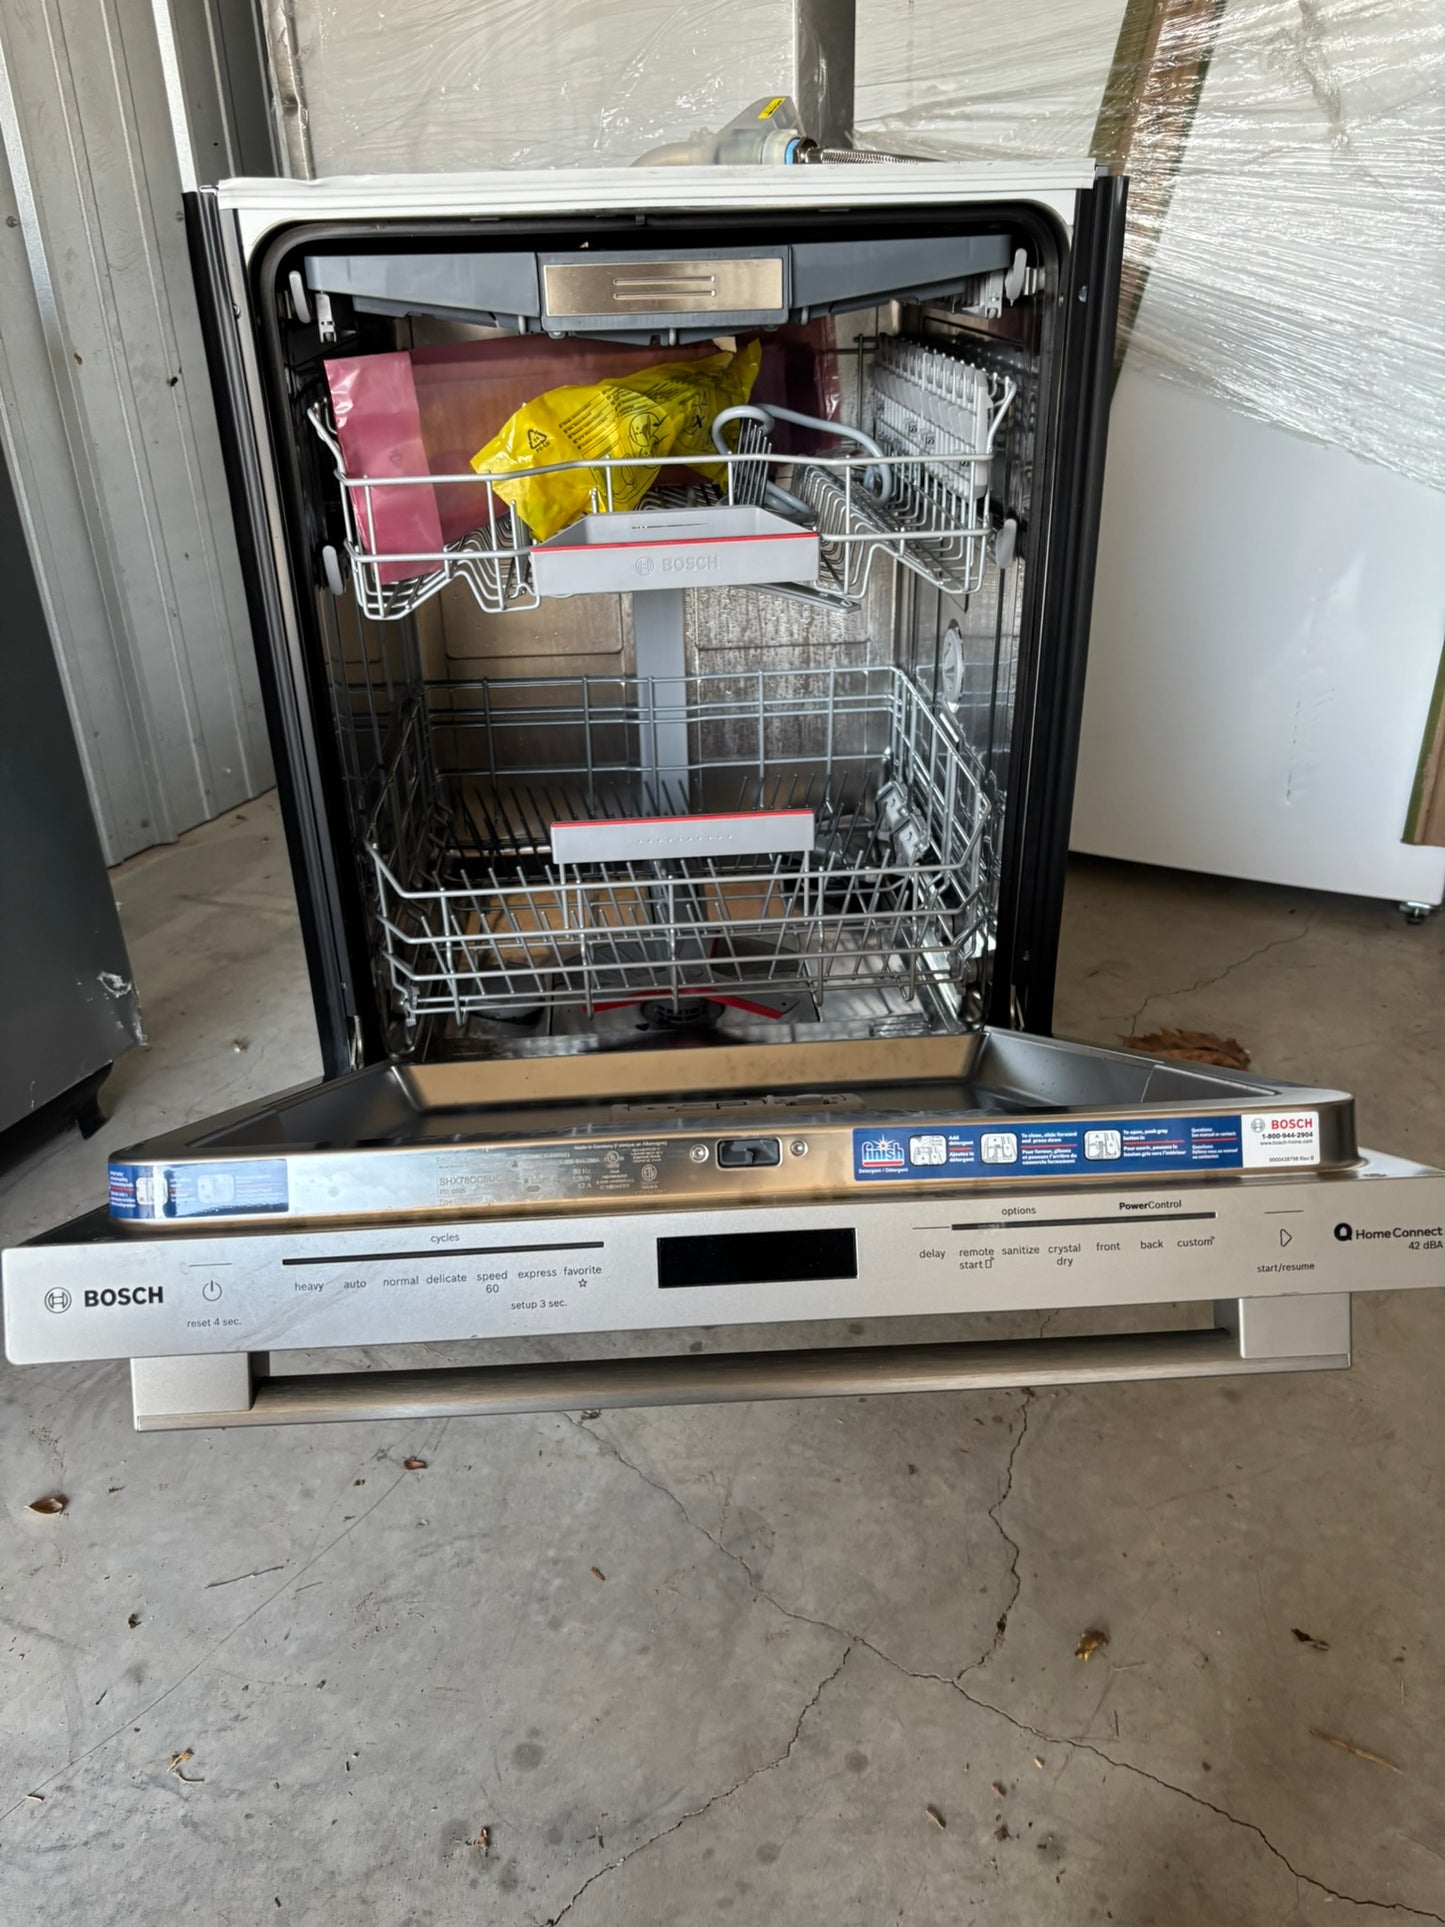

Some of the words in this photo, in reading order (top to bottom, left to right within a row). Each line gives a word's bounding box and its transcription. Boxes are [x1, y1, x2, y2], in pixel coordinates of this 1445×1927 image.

[661, 555, 720, 572] BOSCH
[1271, 1118, 1313, 1130] BOSCH
[1262, 1132, 1313, 1140] 1-800-944-2904
[862, 1141, 905, 1161] finish
[1119, 1200, 1182, 1210] PowerControl
[1001, 1206, 1036, 1217] options
[430, 1233, 460, 1244] cycles
[1355, 1228, 1392, 1240] Home
[1392, 1226, 1443, 1238] Connect
[1048, 1243, 1082, 1254] crystal
[1096, 1242, 1120, 1252] front
[1140, 1240, 1164, 1250] back
[1177, 1238, 1213, 1248] custom
[1408, 1241, 1420, 1250] 42
[1423, 1240, 1444, 1250] dBA
[919, 1249, 946, 1260] delay
[959, 1248, 994, 1257] remote
[1002, 1246, 1040, 1256] sanitize
[960, 1260, 984, 1270] start
[1056, 1256, 1073, 1267] dry
[564, 1265, 602, 1276] favorite
[1257, 1262, 1315, 1273] start/resume
[426, 1273, 468, 1284] delicate
[476, 1270, 508, 1282] speed
[517, 1268, 558, 1280] express
[344, 1279, 367, 1290] auto
[383, 1276, 420, 1287] normal
[294, 1282, 324, 1293] heavy
[486, 1284, 500, 1294] 60
[84, 1286, 164, 1308] BOSCH
[512, 1300, 537, 1310] setup
[540, 1299, 546, 1308] 3
[548, 1300, 568, 1308] sec.
[187, 1318, 211, 1328] reset
[214, 1317, 220, 1327] 4
[223, 1317, 242, 1327] sec.
